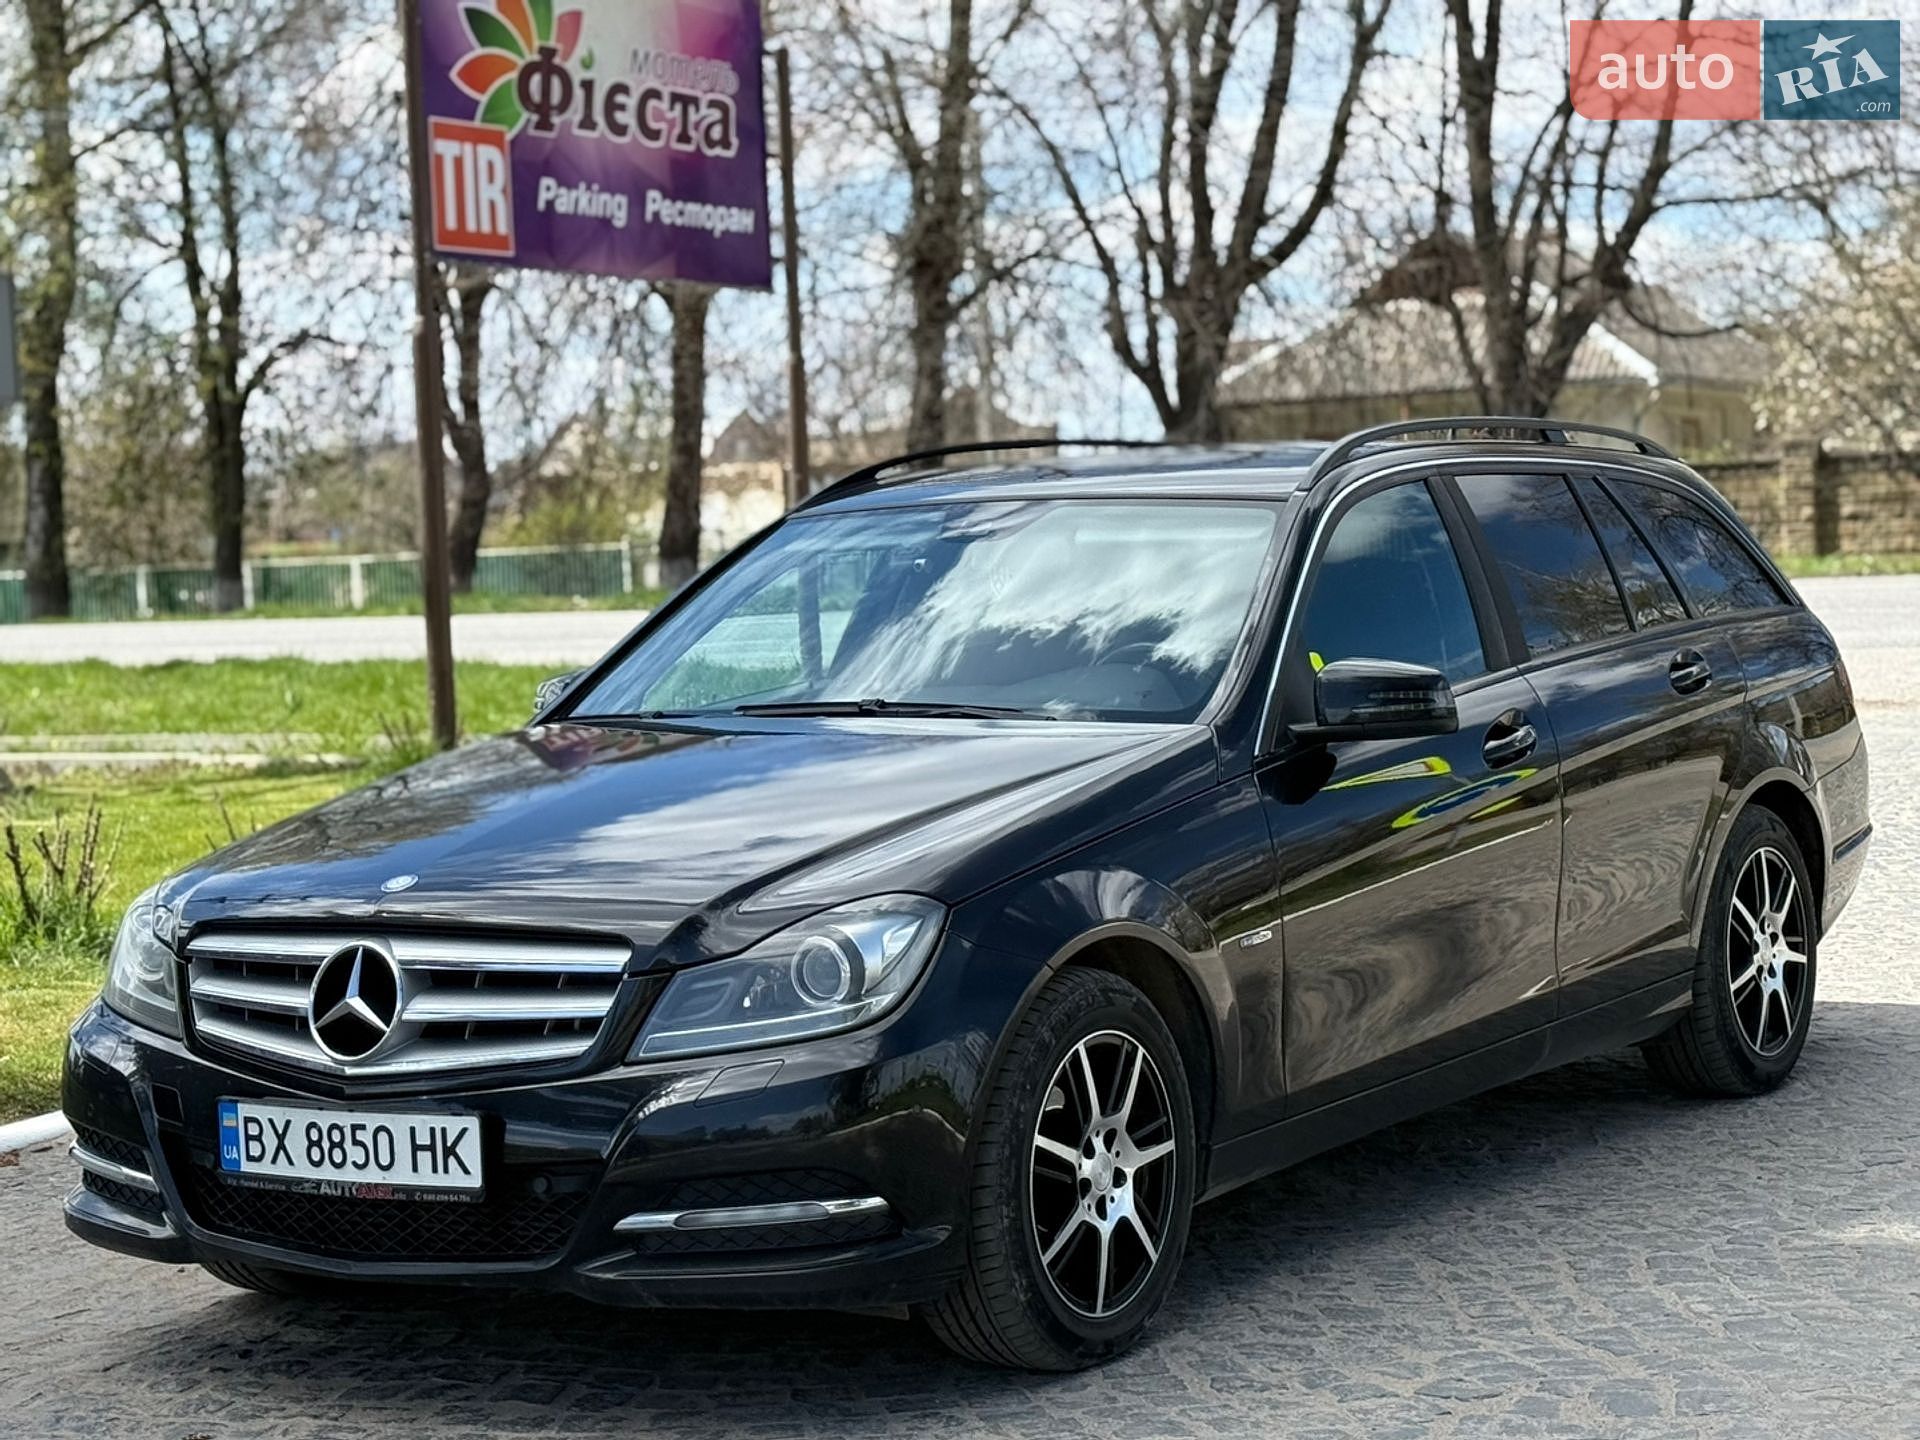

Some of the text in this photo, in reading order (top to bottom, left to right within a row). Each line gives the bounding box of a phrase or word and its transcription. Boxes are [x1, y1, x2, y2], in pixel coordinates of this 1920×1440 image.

[433, 138, 509, 237] TIR
[537, 176, 629, 228] Parking
[644, 189, 755, 238] Ресторан
[223, 1144, 240, 1161] UA
[243, 1115, 471, 1176] BX 8850 HK
